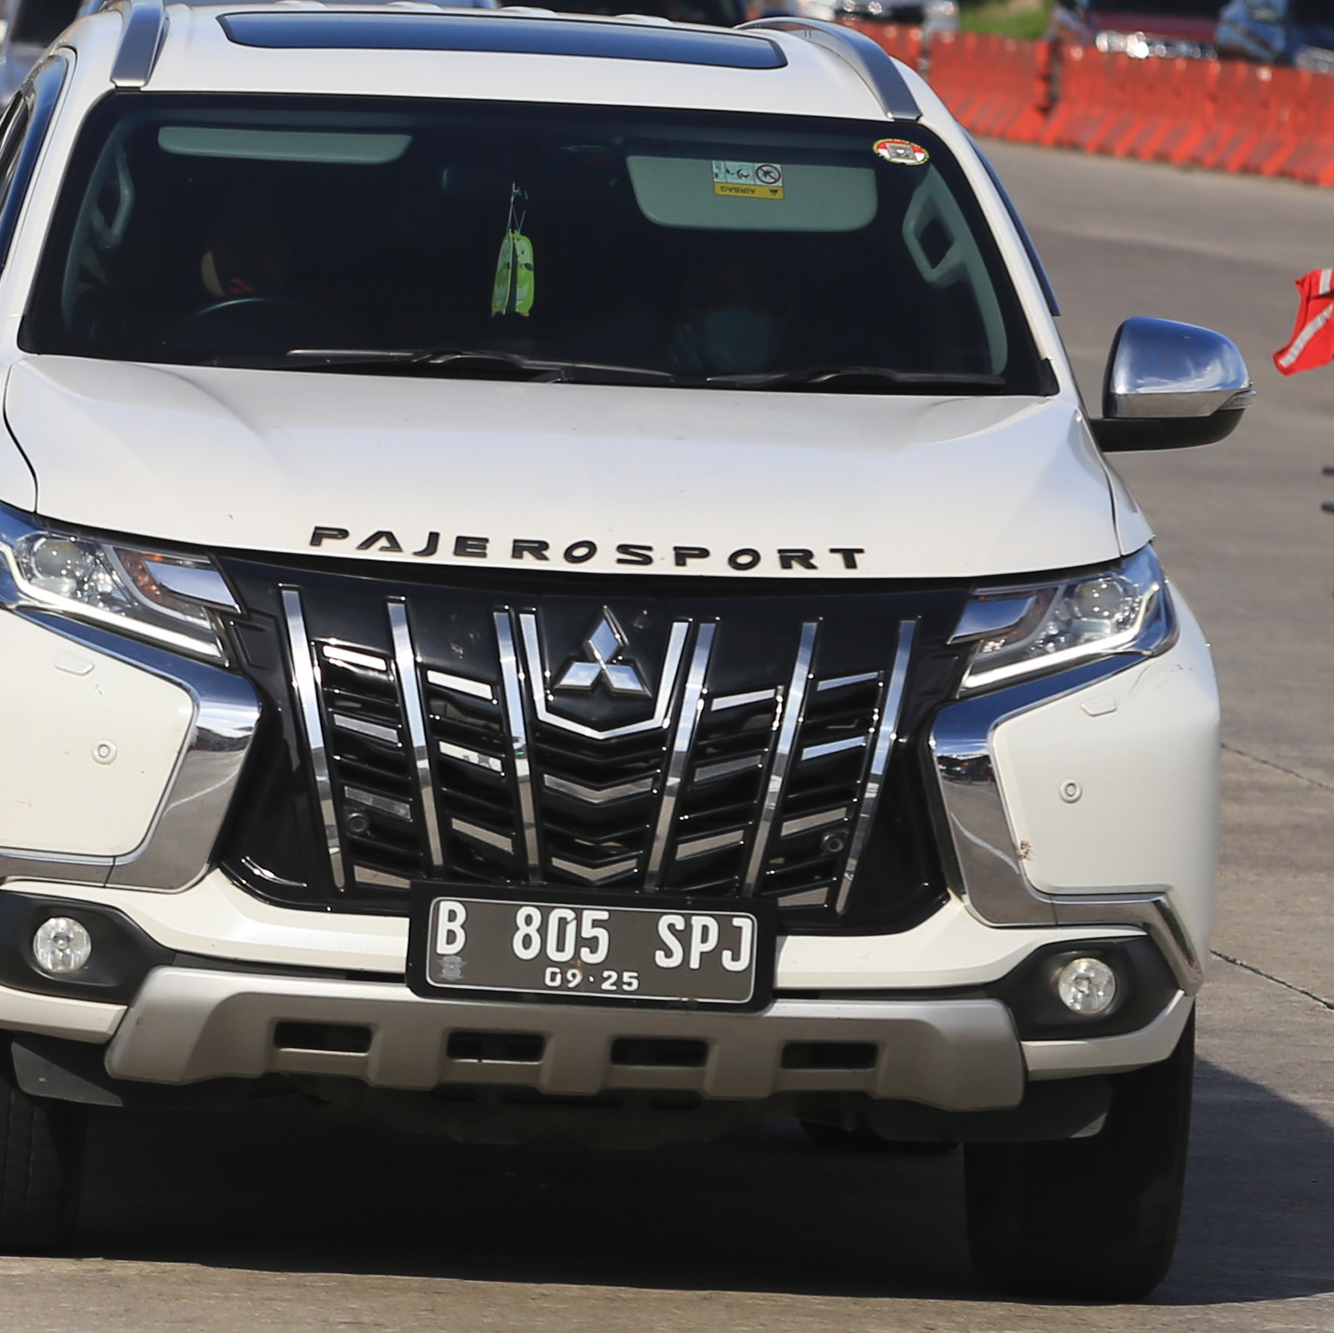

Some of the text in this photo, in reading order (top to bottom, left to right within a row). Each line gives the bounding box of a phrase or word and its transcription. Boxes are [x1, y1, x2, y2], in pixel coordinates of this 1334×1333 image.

[436, 901, 754, 972] B 805 SPJ
